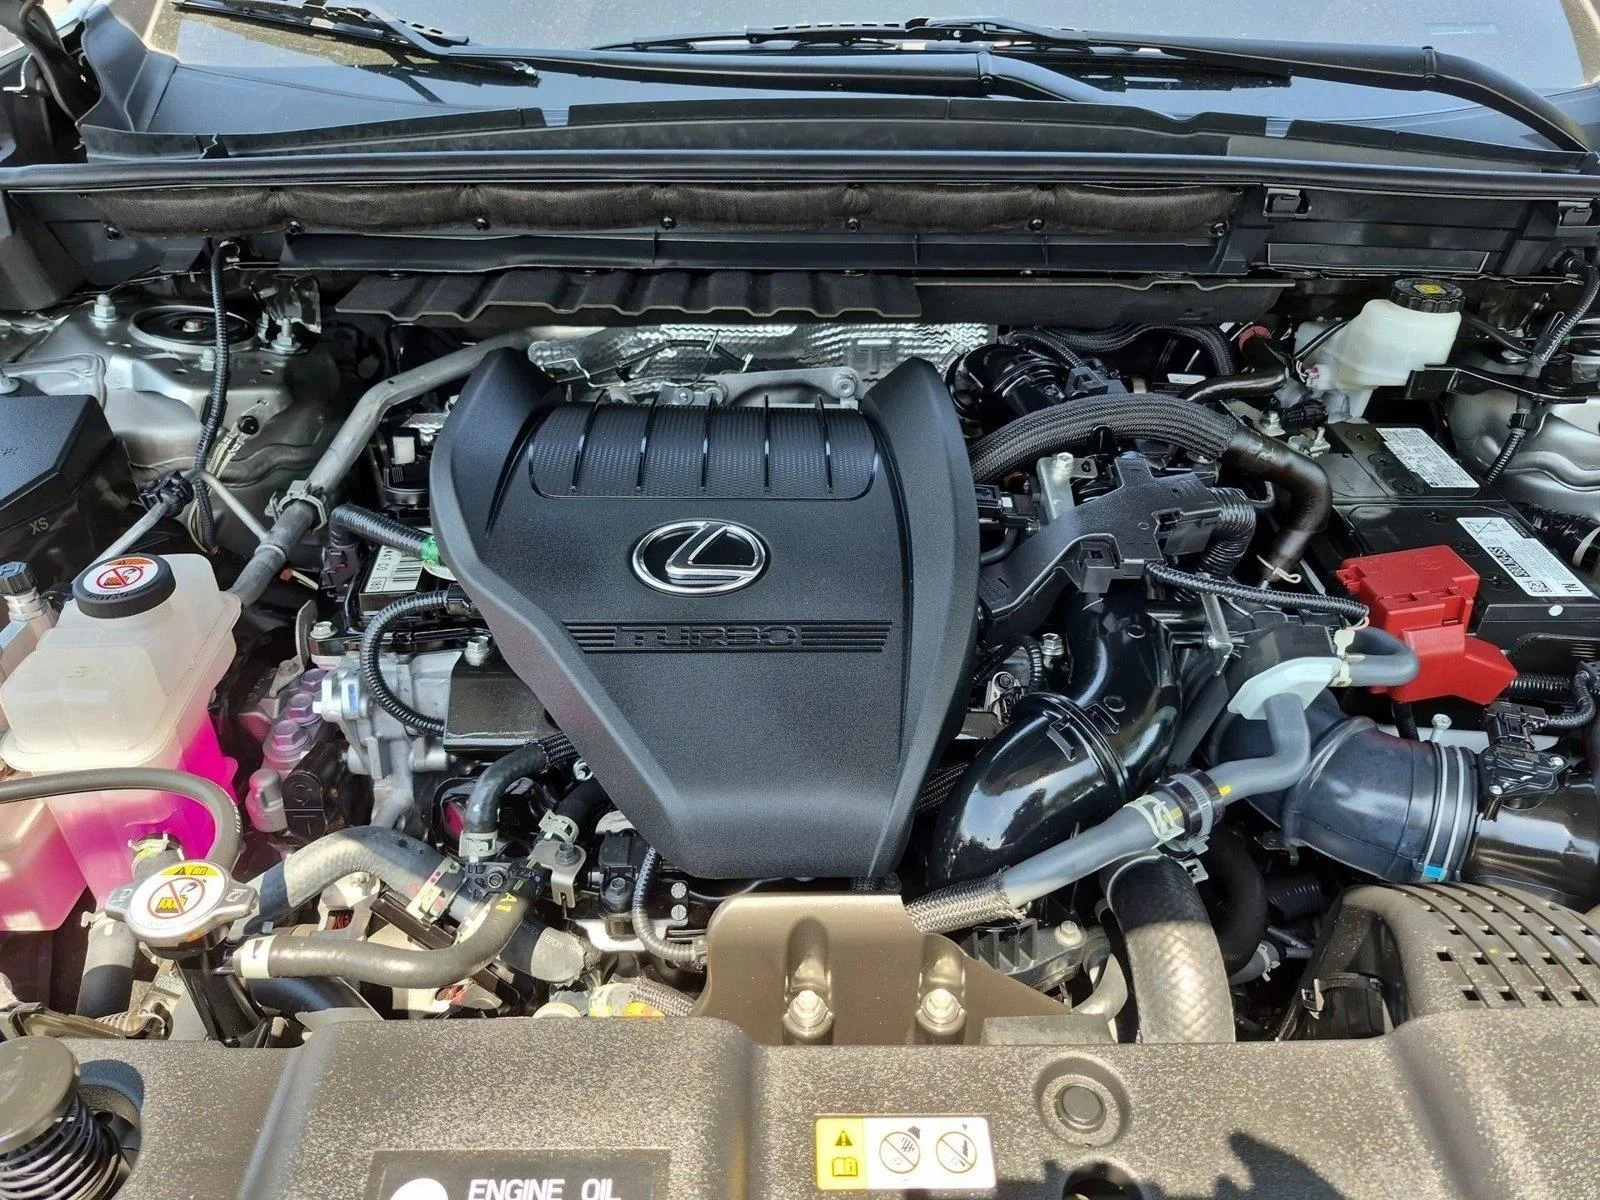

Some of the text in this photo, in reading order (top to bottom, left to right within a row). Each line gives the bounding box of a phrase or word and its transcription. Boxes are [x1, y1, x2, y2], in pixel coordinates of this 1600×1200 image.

[619, 625, 797, 646] TURBO
[467, 1178, 622, 1200] ENGINE OIL
